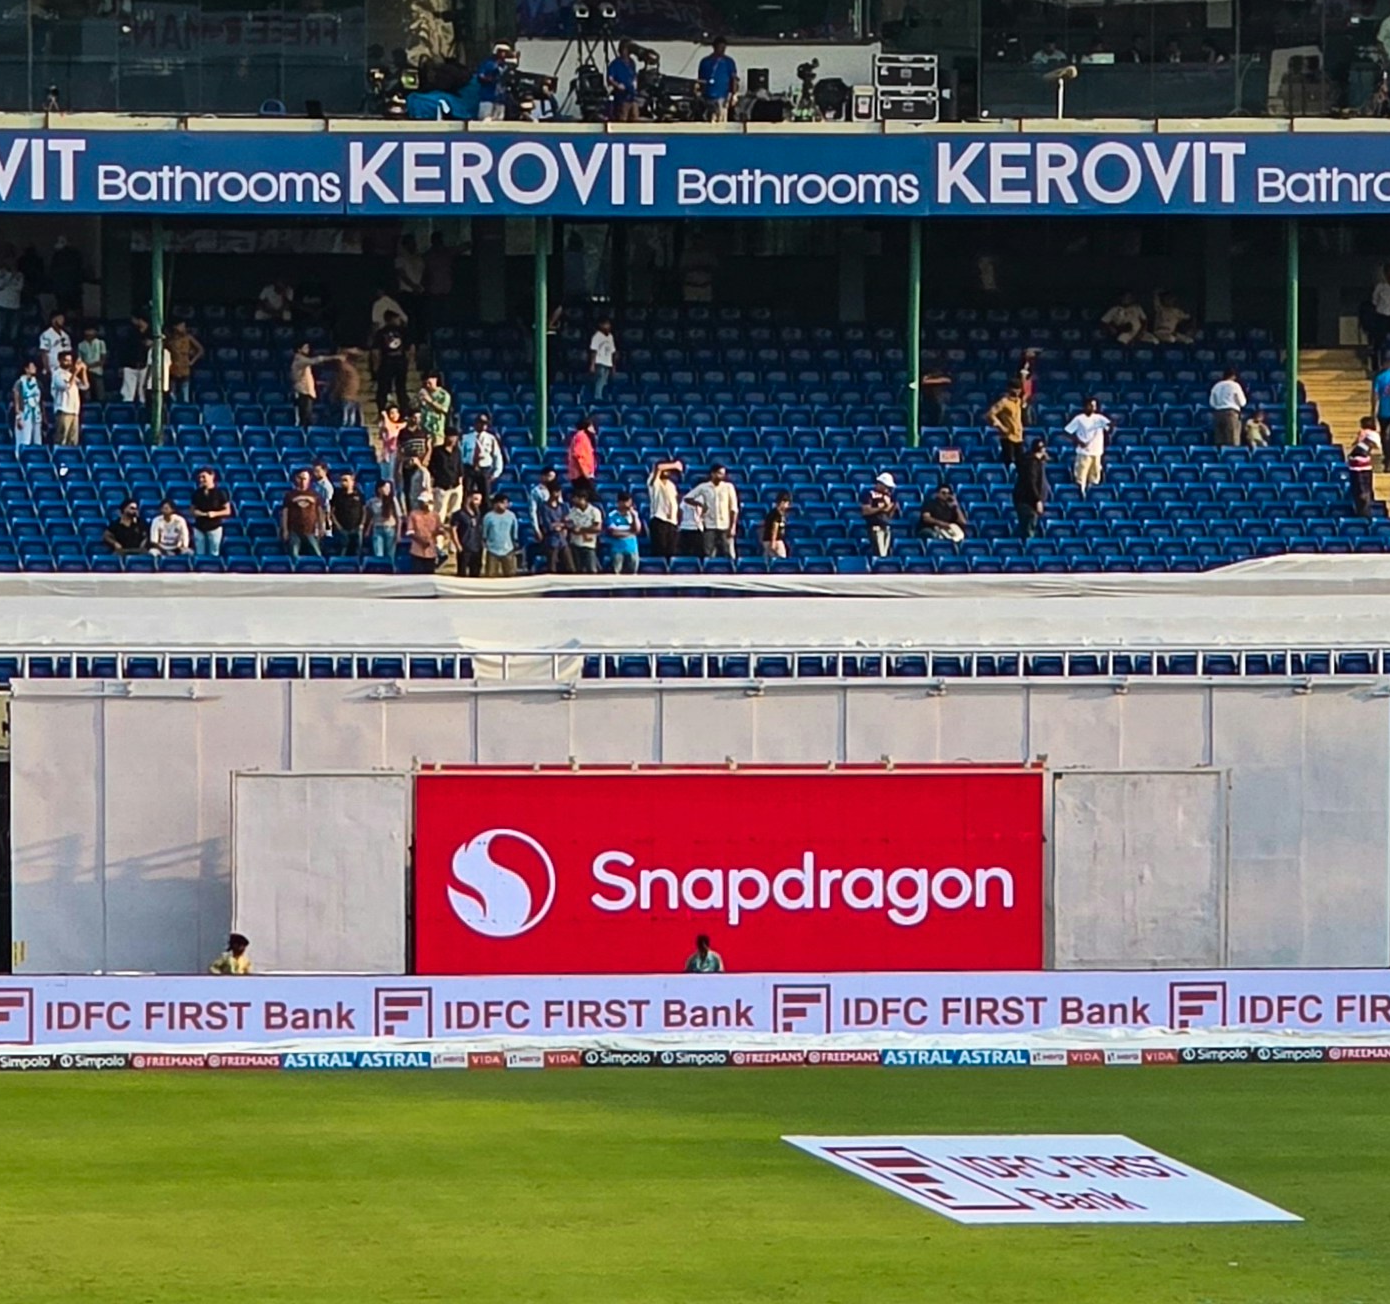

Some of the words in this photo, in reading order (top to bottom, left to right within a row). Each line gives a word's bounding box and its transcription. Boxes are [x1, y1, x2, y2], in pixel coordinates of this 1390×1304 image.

[348, 141, 667, 205] KEROVIT
[677, 168, 919, 205] Bathrooms
[937, 141, 1246, 204] KEROVIT
[97, 164, 340, 203] Bathrooms
[590, 851, 1014, 926] Snapdragon
[47, 1001, 131, 1031] IDFC
[145, 1001, 251, 1030] FIRST
[265, 1000, 355, 1030] Bank
[445, 1000, 530, 1029] IDFC
[544, 999, 650, 1028] FIRST
[664, 998, 754, 1027] Bank
[844, 997, 927, 1026] IDFC
[942, 996, 1047, 1025] FIRST
[1062, 996, 1150, 1024] Bank
[1239, 995, 1322, 1023] IDFC
[74, 1054, 126, 1069] Simpolo
[145, 1055, 204, 1068] FREEMANS
[221, 1054, 280, 1067] FREEMANS
[285, 1053, 353, 1067] ASTRAL
[360, 1053, 429, 1067] ASTRAL
[472, 1055, 500, 1064] VIDA
[548, 1054, 578, 1064] VIDA
[600, 1051, 650, 1065] Simpolo
[676, 1051, 727, 1065] Simpolo
[745, 1052, 803, 1064] FREEMANS
[821, 1051, 879, 1063] FREEMANS
[884, 1050, 952, 1064] ASTRAL
[958, 1050, 1027, 1064] ASTRAL
[1071, 1052, 1099, 1062] VIDA
[1146, 1052, 1174, 1062] VIDA
[1197, 1048, 1248, 1062] Simpolo
[1272, 1048, 1323, 1062] Simpolo
[0, 1055, 50, 1070] Simpolo
[947, 1155, 1070, 1178] IDFC
[1054, 1155, 1188, 1177] FIRST
[1017, 1188, 1148, 1210] Bank
